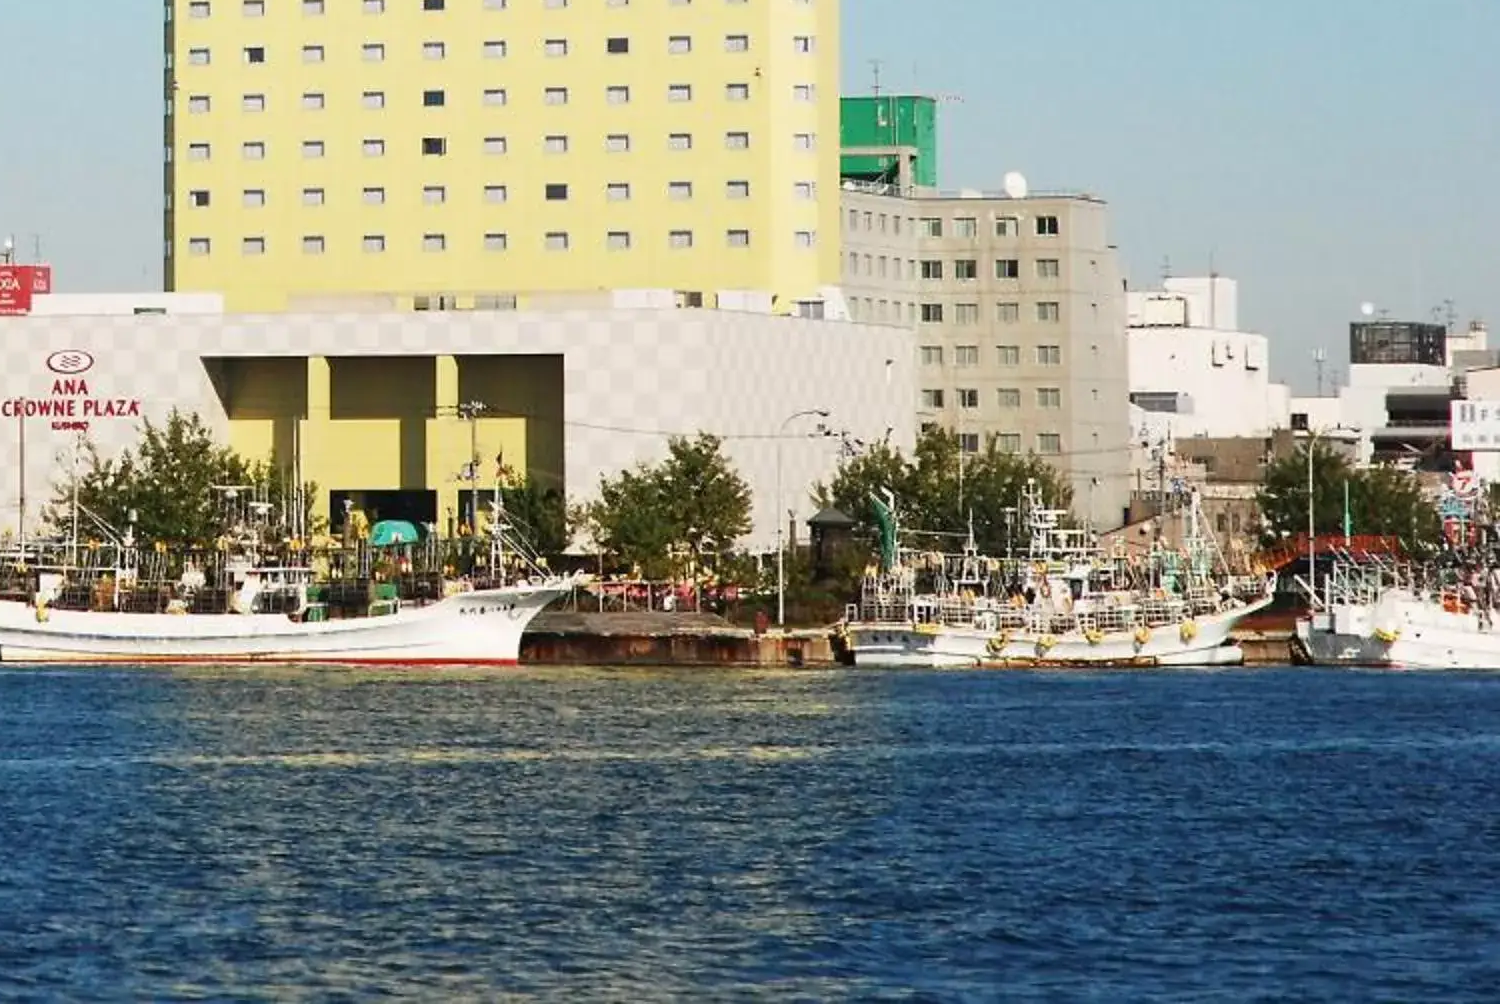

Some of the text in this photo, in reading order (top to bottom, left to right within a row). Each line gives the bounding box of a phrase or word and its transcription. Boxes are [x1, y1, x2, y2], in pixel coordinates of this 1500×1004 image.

[51, 378, 88, 396] ANA
[1, 399, 140, 417] CROWNE PLAZA
